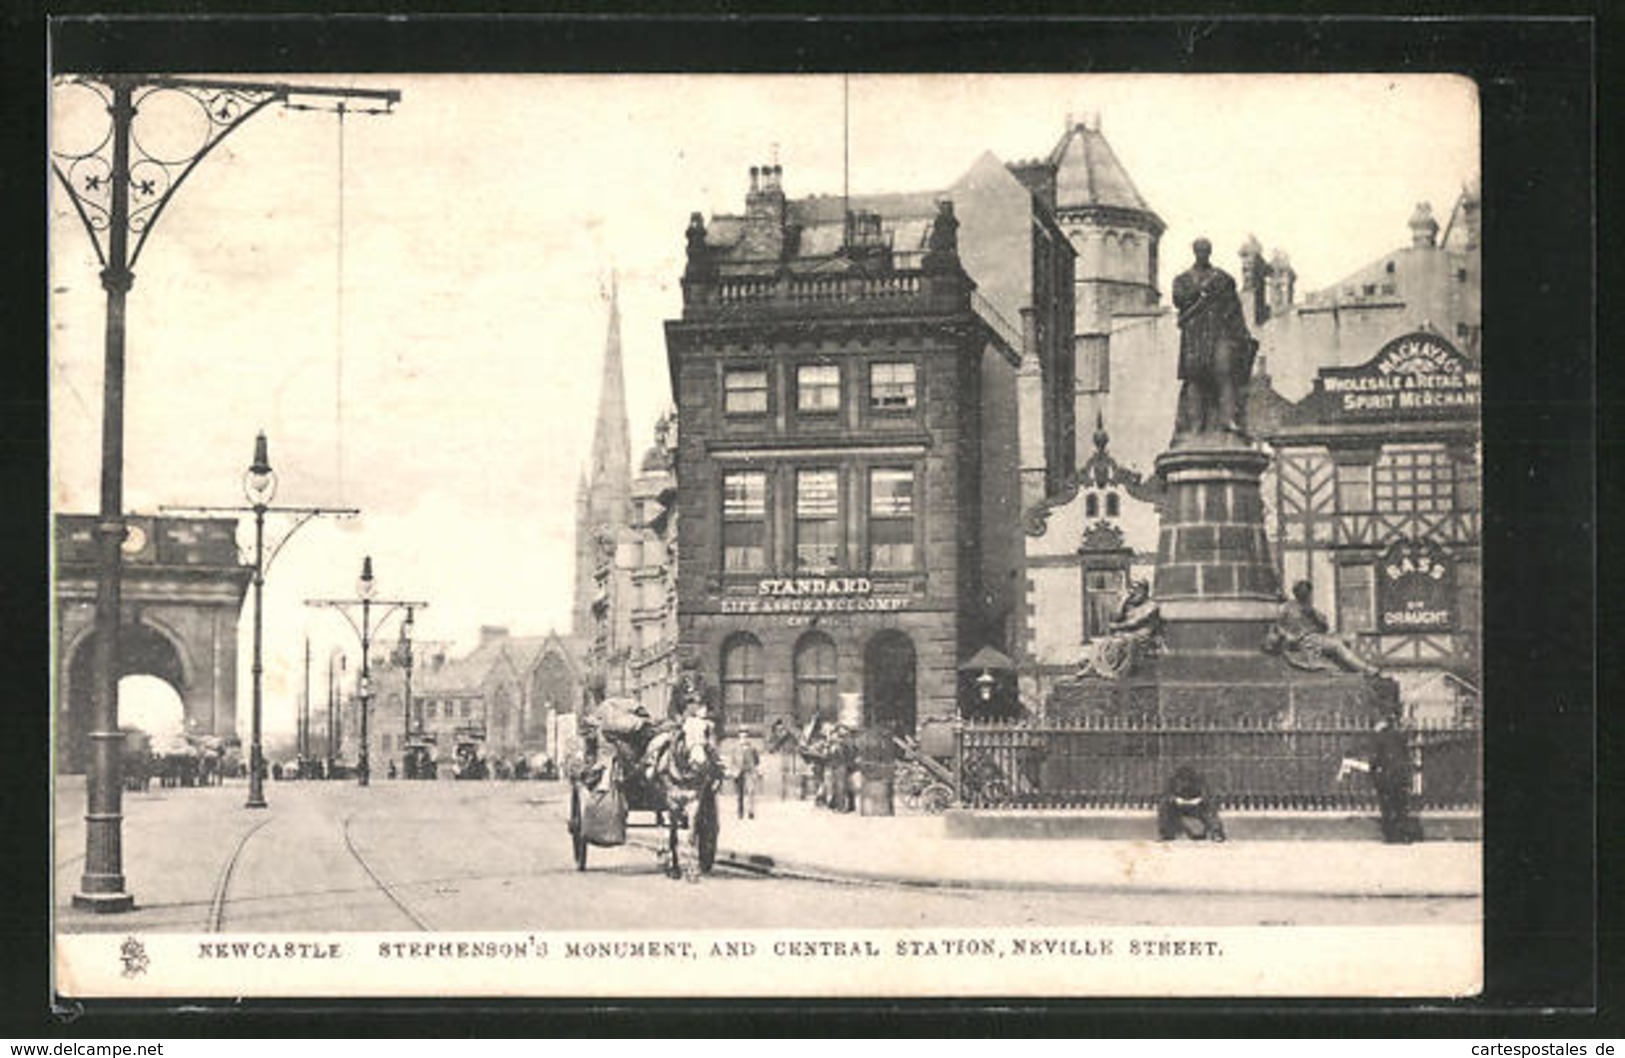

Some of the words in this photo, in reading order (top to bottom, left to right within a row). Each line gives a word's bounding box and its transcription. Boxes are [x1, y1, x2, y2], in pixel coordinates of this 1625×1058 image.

[1323, 375, 1401, 391] WHOLESALE
[1416, 372, 1464, 388] RETAIL
[1344, 394, 1395, 410] SPIRIT
[758, 577, 871, 595] STANDARD
[721, 600, 759, 613] LIFE
[761, 599, 856, 612] ASSURANCE
[1384, 610, 1448, 626] DRAUGHT
